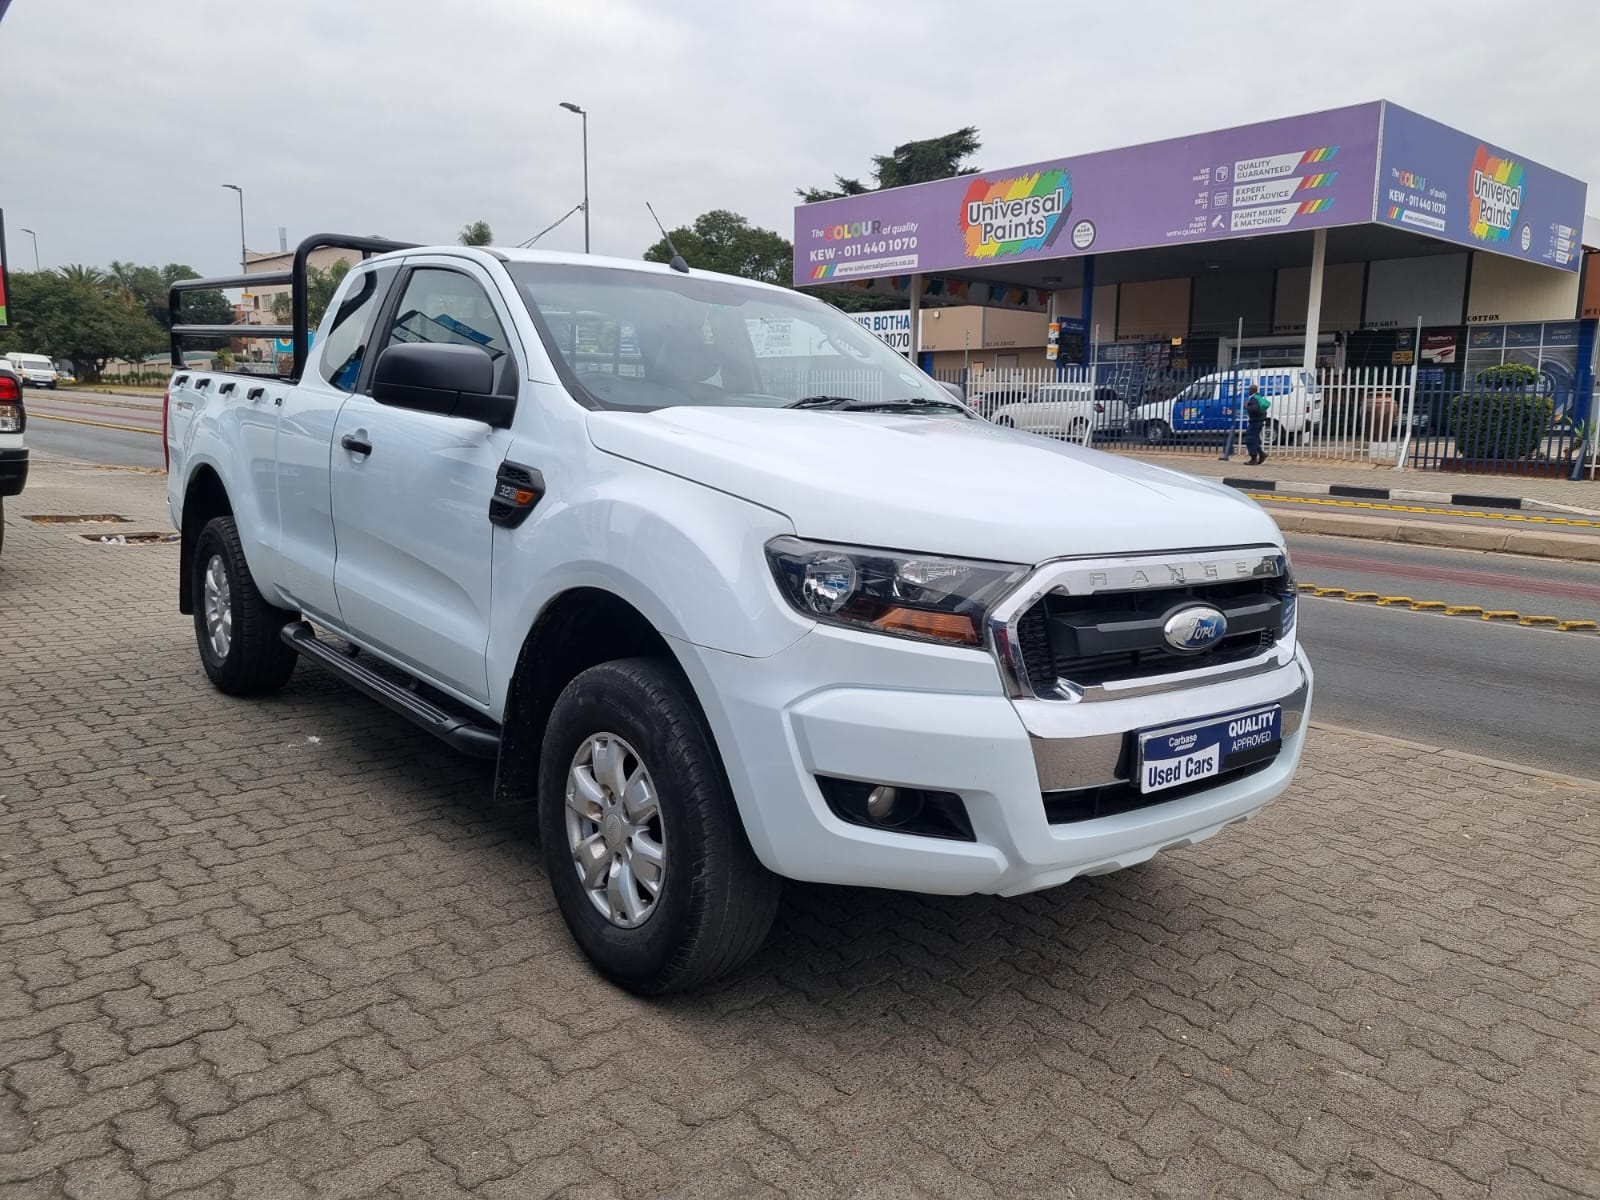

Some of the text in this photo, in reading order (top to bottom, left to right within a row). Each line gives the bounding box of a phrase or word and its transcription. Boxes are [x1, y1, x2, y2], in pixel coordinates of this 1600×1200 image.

[1237, 159, 1271, 171] QUALITY
[1237, 165, 1291, 179] GUARANTEED
[1235, 191, 1289, 204] PAINT ADVICE
[1236, 185, 1266, 196] EXPERT
[1474, 171, 1520, 208] Universal
[968, 189, 1062, 224] Universal
[1389, 189, 1405, 204] KEW
[1409, 195, 1419, 207] 011
[1419, 198, 1431, 210] 440
[1432, 201, 1446, 215] 1070
[1234, 207, 1287, 220] PAINT MIXING
[1240, 216, 1281, 227] MATCHING
[1480, 200, 1510, 227] Paints
[812, 220, 918, 240] The COLOUR of quality
[983, 216, 1045, 242] Paints
[810, 247, 836, 261] KEW
[844, 243, 861, 257] 011
[863, 240, 886, 255] 440
[888, 236, 918, 251] 1070
[838, 259, 915, 273] www.universalpaints.co.za
[874, 314, 910, 331] BOTHA
[1467, 314, 1499, 322] COTTON
[884, 332, 910, 348] 1070
[1090, 559, 1275, 586] RANGER
[1188, 617, 1217, 643] Ford
[1229, 711, 1276, 737] QUALITY
[1168, 733, 1198, 748] Carbase
[1232, 730, 1272, 752] APPROVED
[1148, 756, 1213, 788] Used Cars
